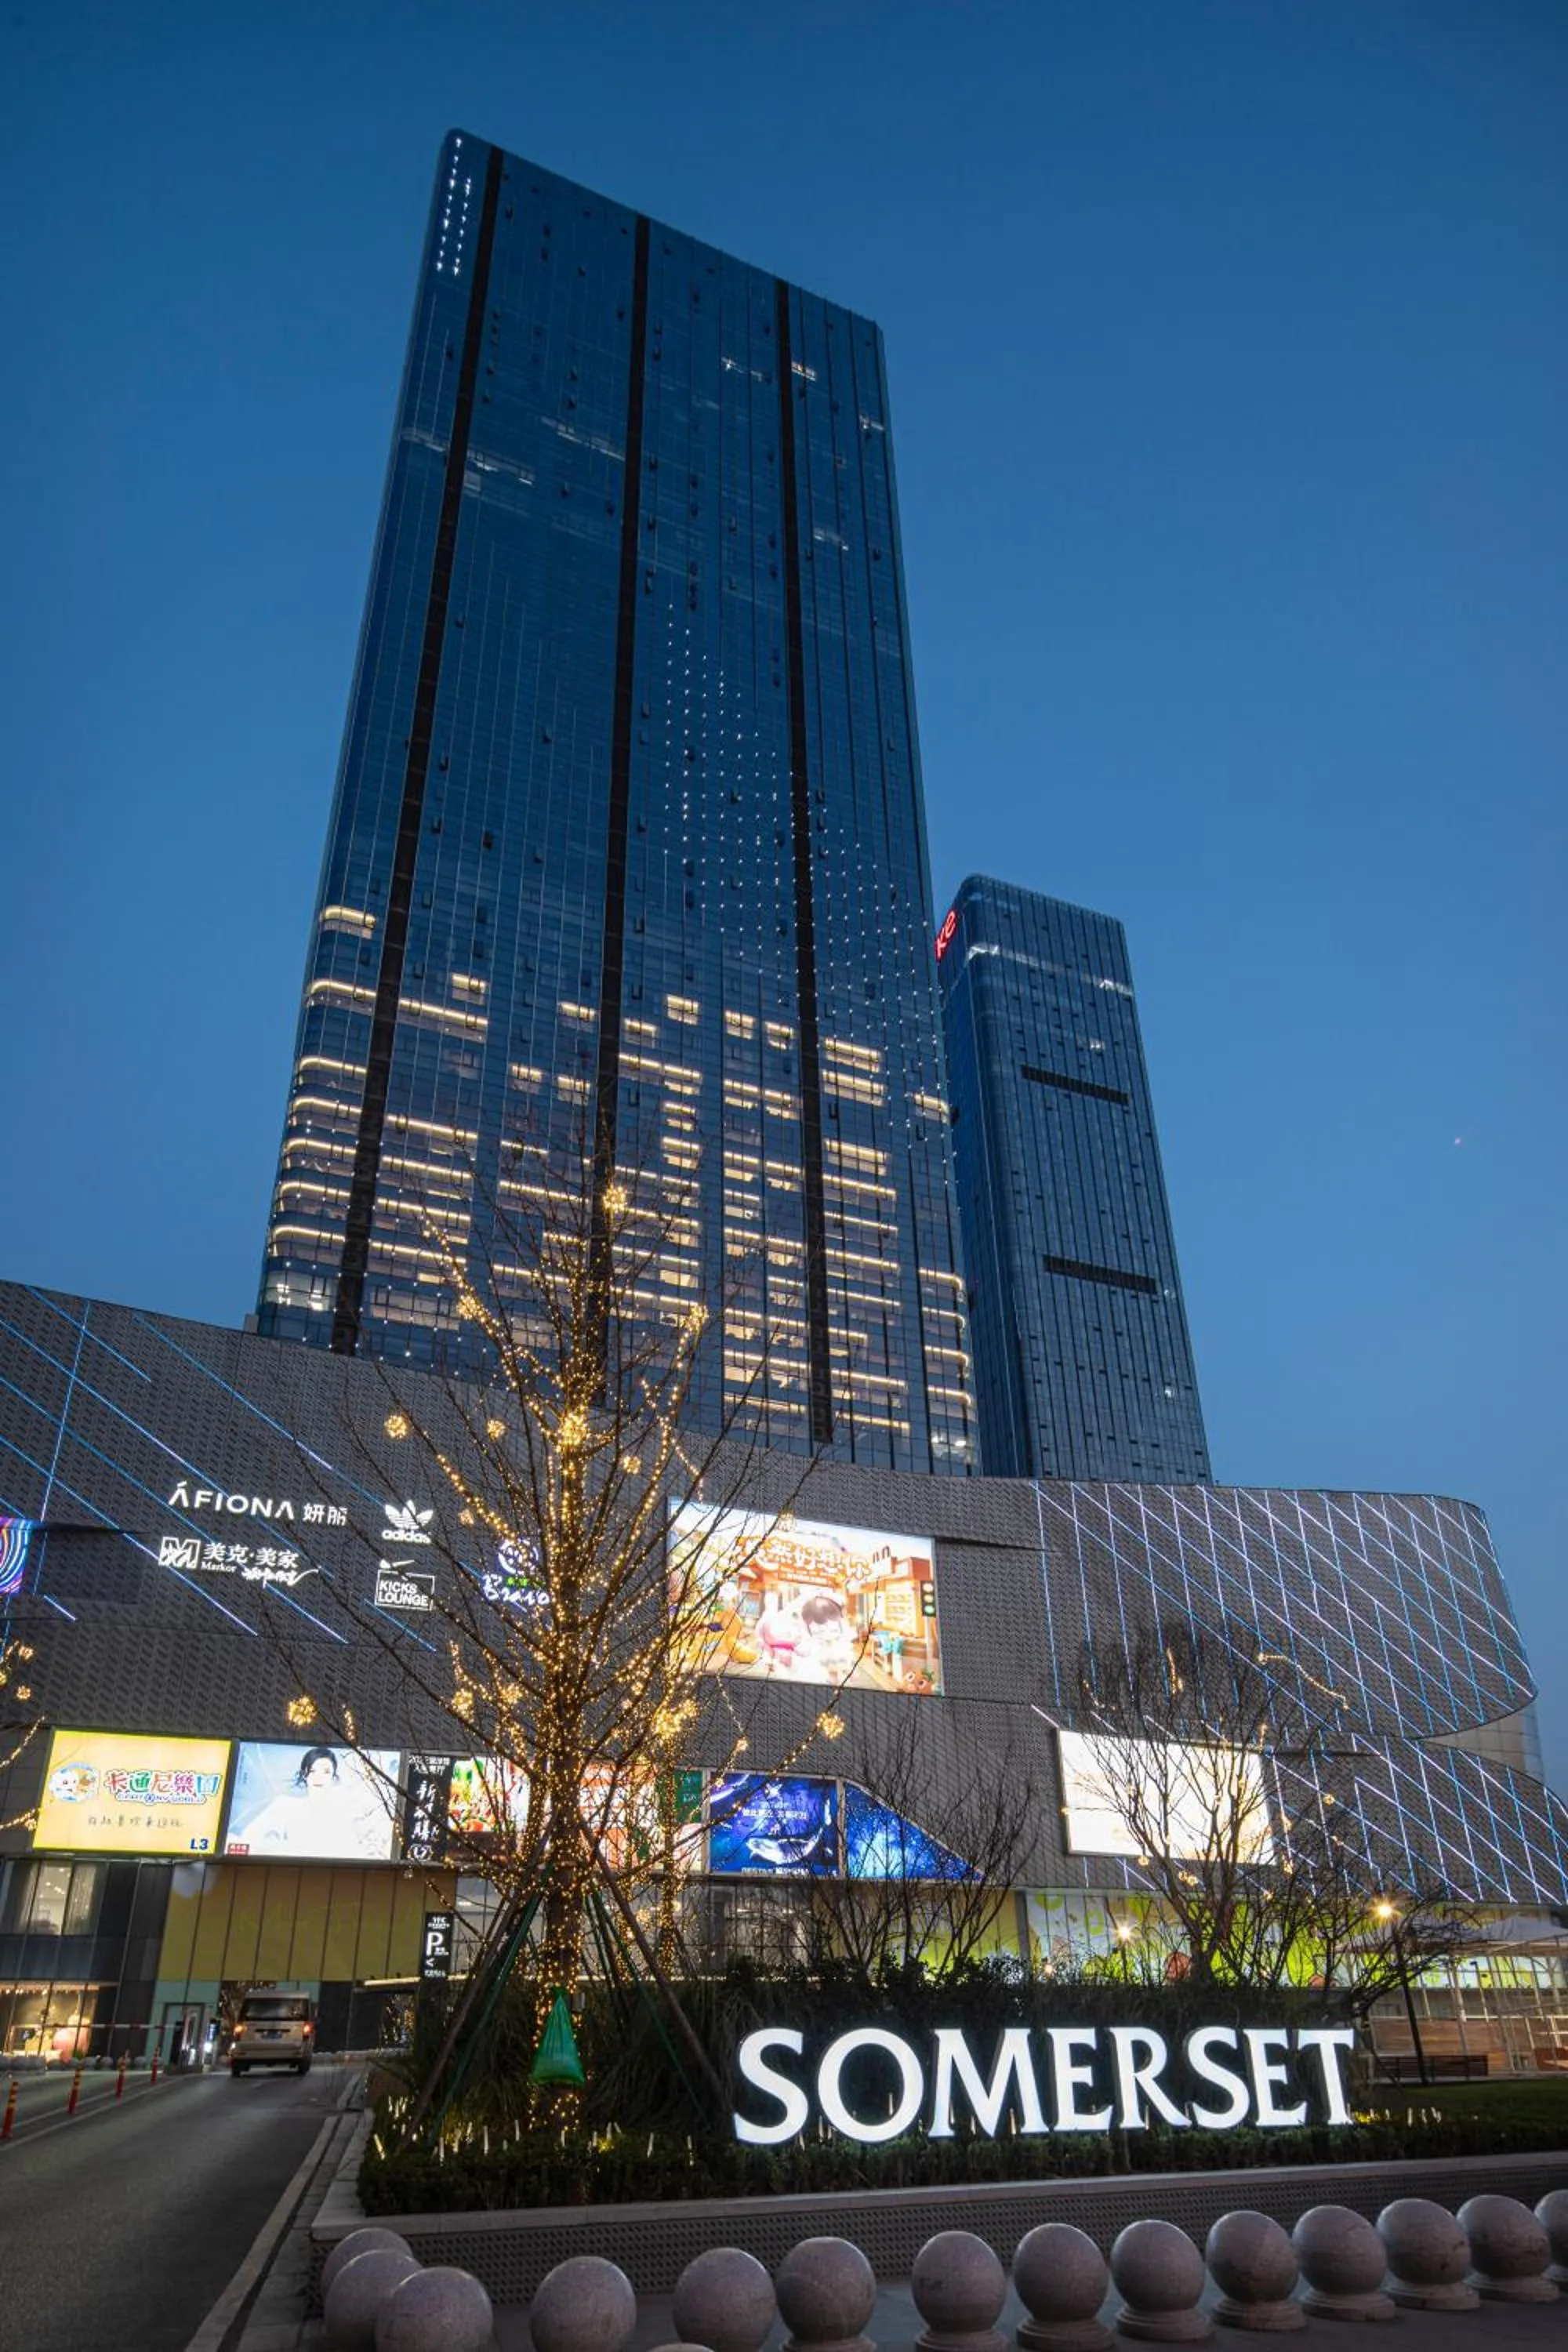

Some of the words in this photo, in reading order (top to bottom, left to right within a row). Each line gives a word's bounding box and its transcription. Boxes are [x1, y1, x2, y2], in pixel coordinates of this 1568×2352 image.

[382, 1530, 431, 1544] adidas
[379, 1580, 418, 1595] KICKS
[378, 1591, 429, 1606] LOUNGE
[190, 1838, 209, 1850] L3
[426, 1932, 444, 1956] P
[734, 2027, 1355, 2144] SOMERSET
